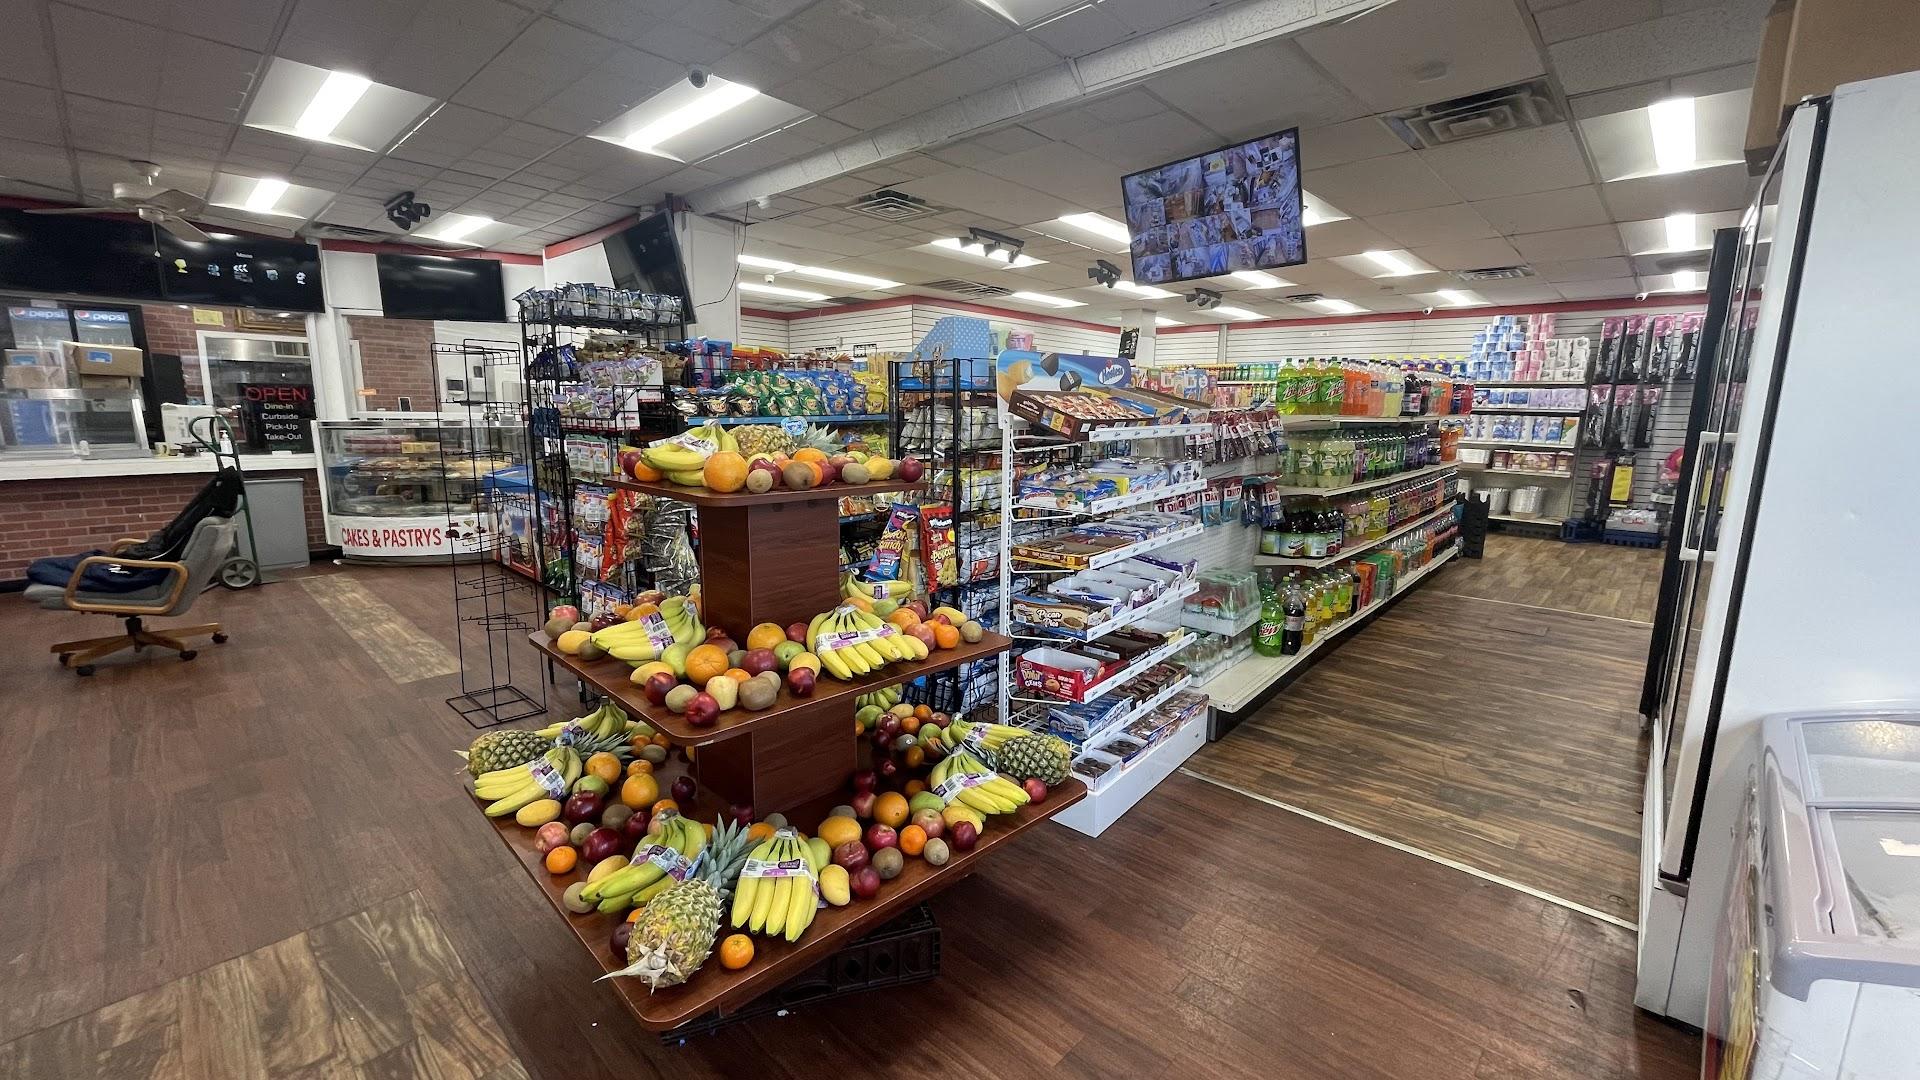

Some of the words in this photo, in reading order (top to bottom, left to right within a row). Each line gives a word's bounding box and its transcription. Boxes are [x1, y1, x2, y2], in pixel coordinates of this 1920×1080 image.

[28, 310, 65, 319] pepsi
[92, 312, 126, 321] pepsi
[245, 387, 307, 401] OPEN
[265, 423, 299, 431] Pick-Up
[341, 528, 369, 547] CAKES
[372, 529, 382, 548] &
[383, 528, 442, 548] PASTRYS
[1036, 609, 1062, 620] Pecan
[1021, 669, 1043, 682] DONUT
[1024, 680, 1043, 688] GEMS
